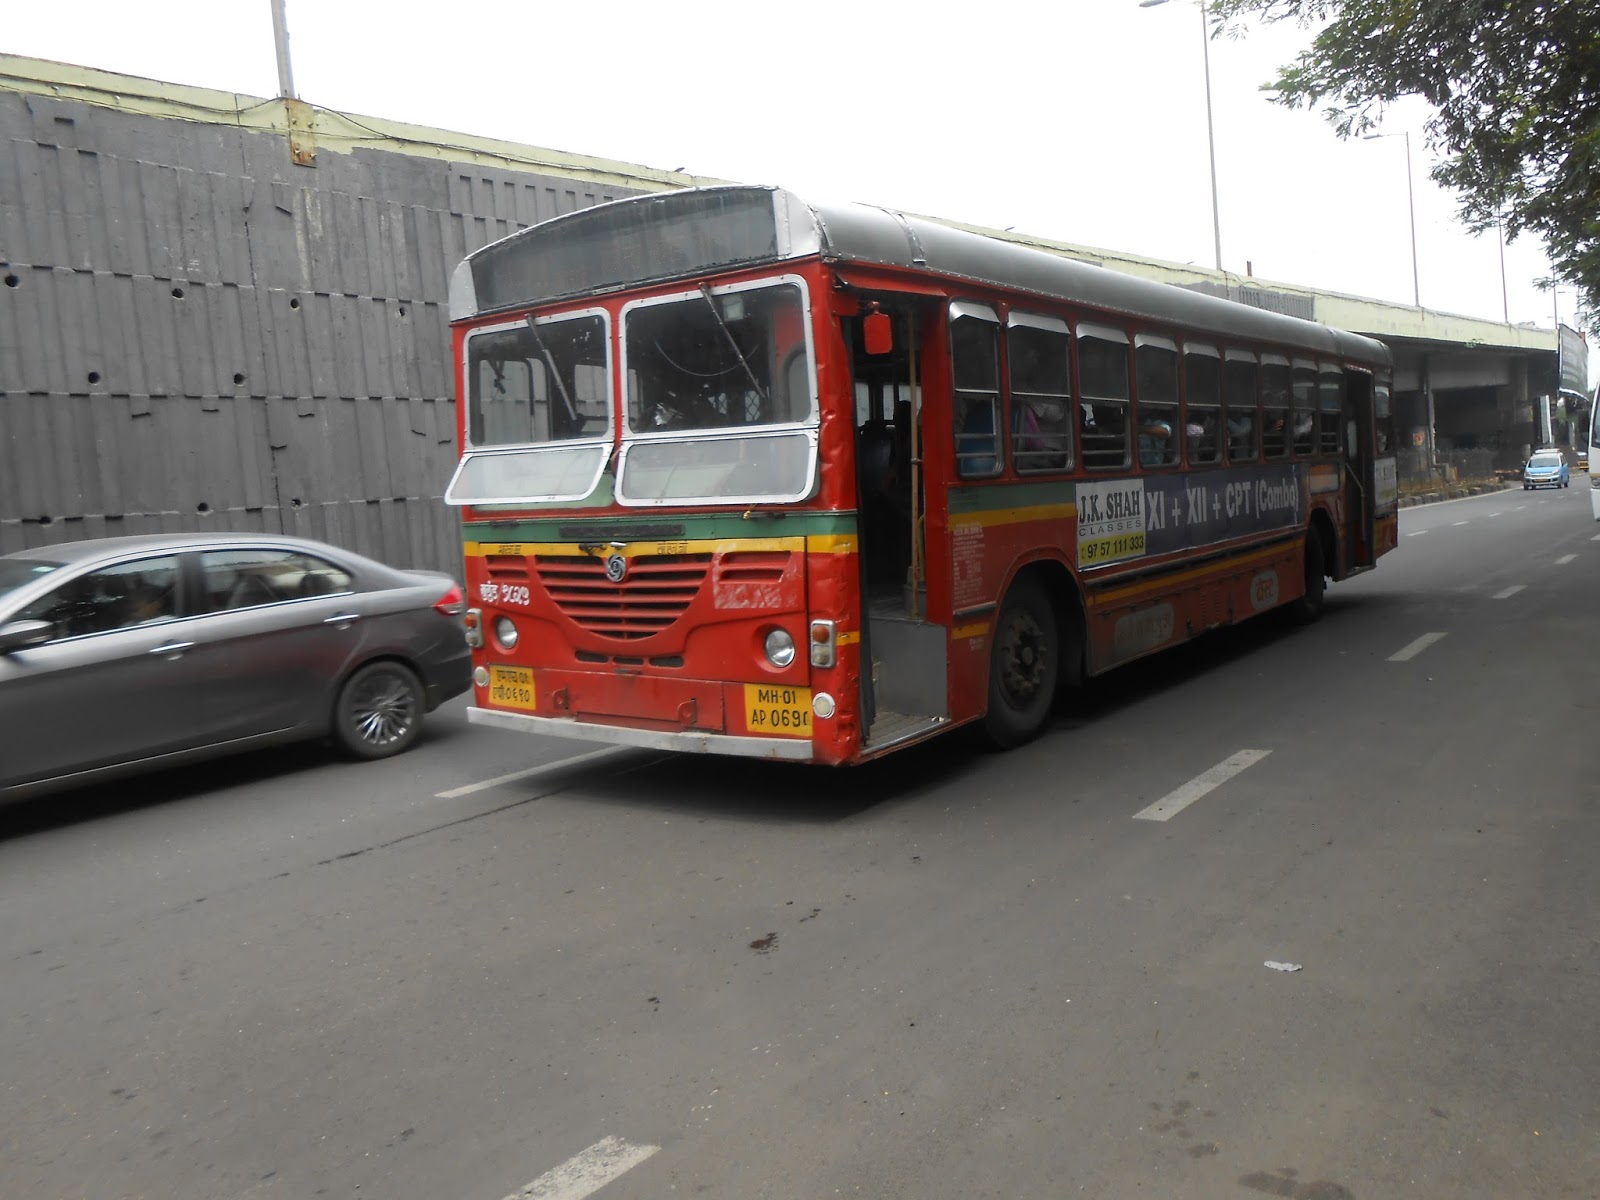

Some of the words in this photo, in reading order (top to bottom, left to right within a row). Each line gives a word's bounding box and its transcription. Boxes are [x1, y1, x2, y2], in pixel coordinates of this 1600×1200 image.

[1079, 494, 1103, 524] J.K.
[1106, 490, 1141, 520] SHAH
[1146, 490, 1166, 531] XI
[1186, 486, 1207, 525] XII
[1225, 481, 1251, 519] CPT
[1255, 477, 1299, 519] (Combo)
[1079, 519, 1142, 537] CLASSES
[751, 709, 767, 725] AP
